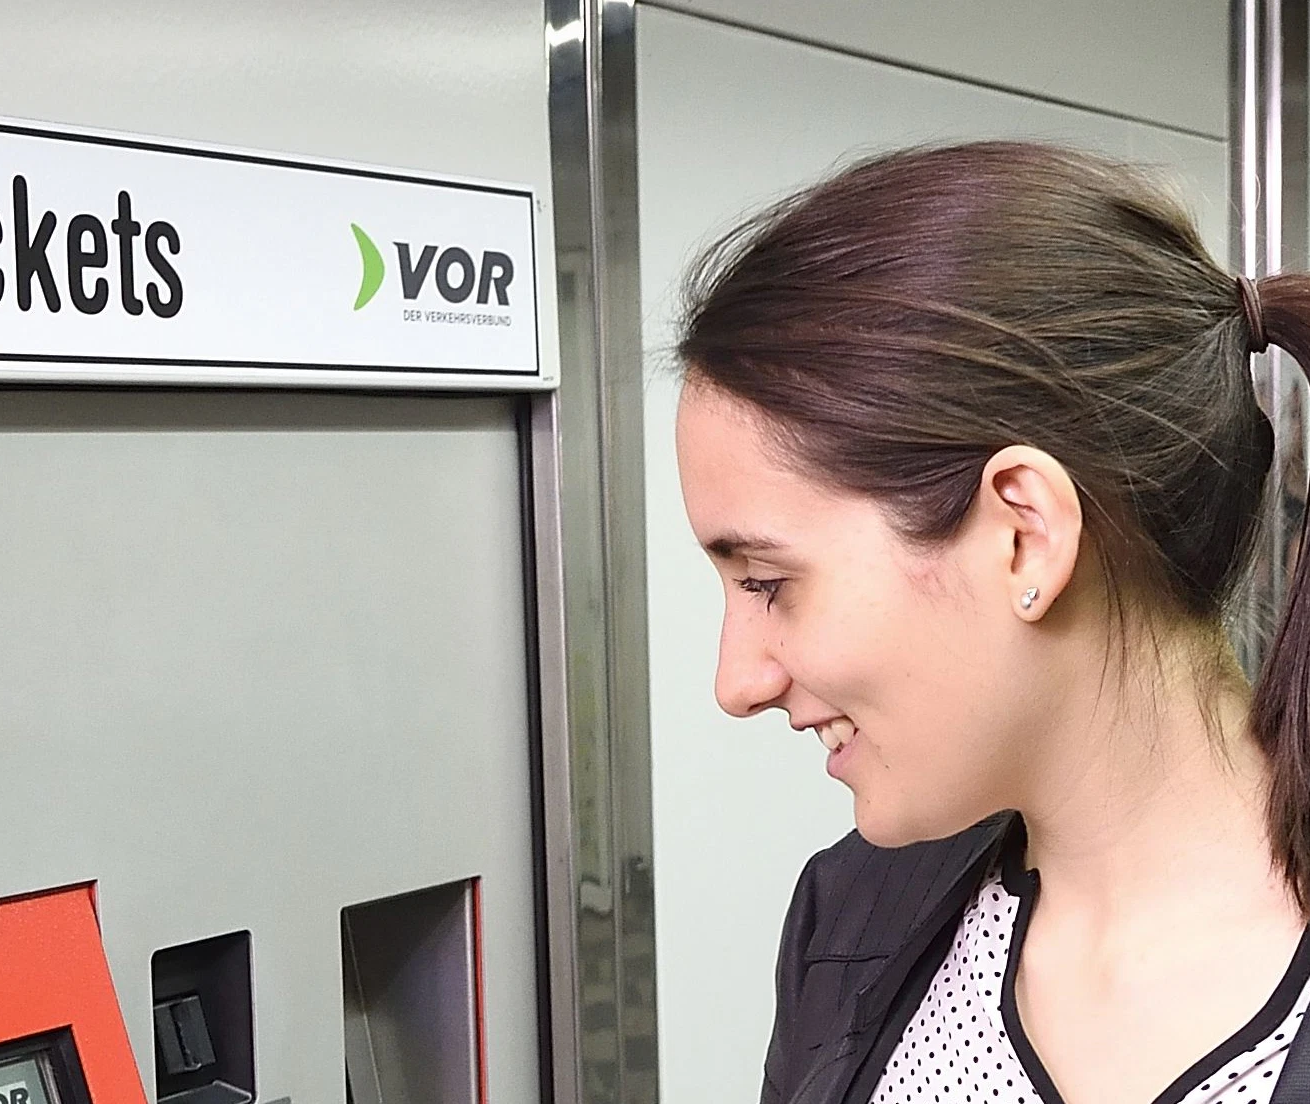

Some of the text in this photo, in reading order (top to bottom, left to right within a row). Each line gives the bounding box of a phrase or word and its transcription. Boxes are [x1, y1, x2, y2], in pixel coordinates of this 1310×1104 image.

[392, 241, 515, 306] VOR
[403, 309, 512, 327] DER VERKEHRSVERBUND
